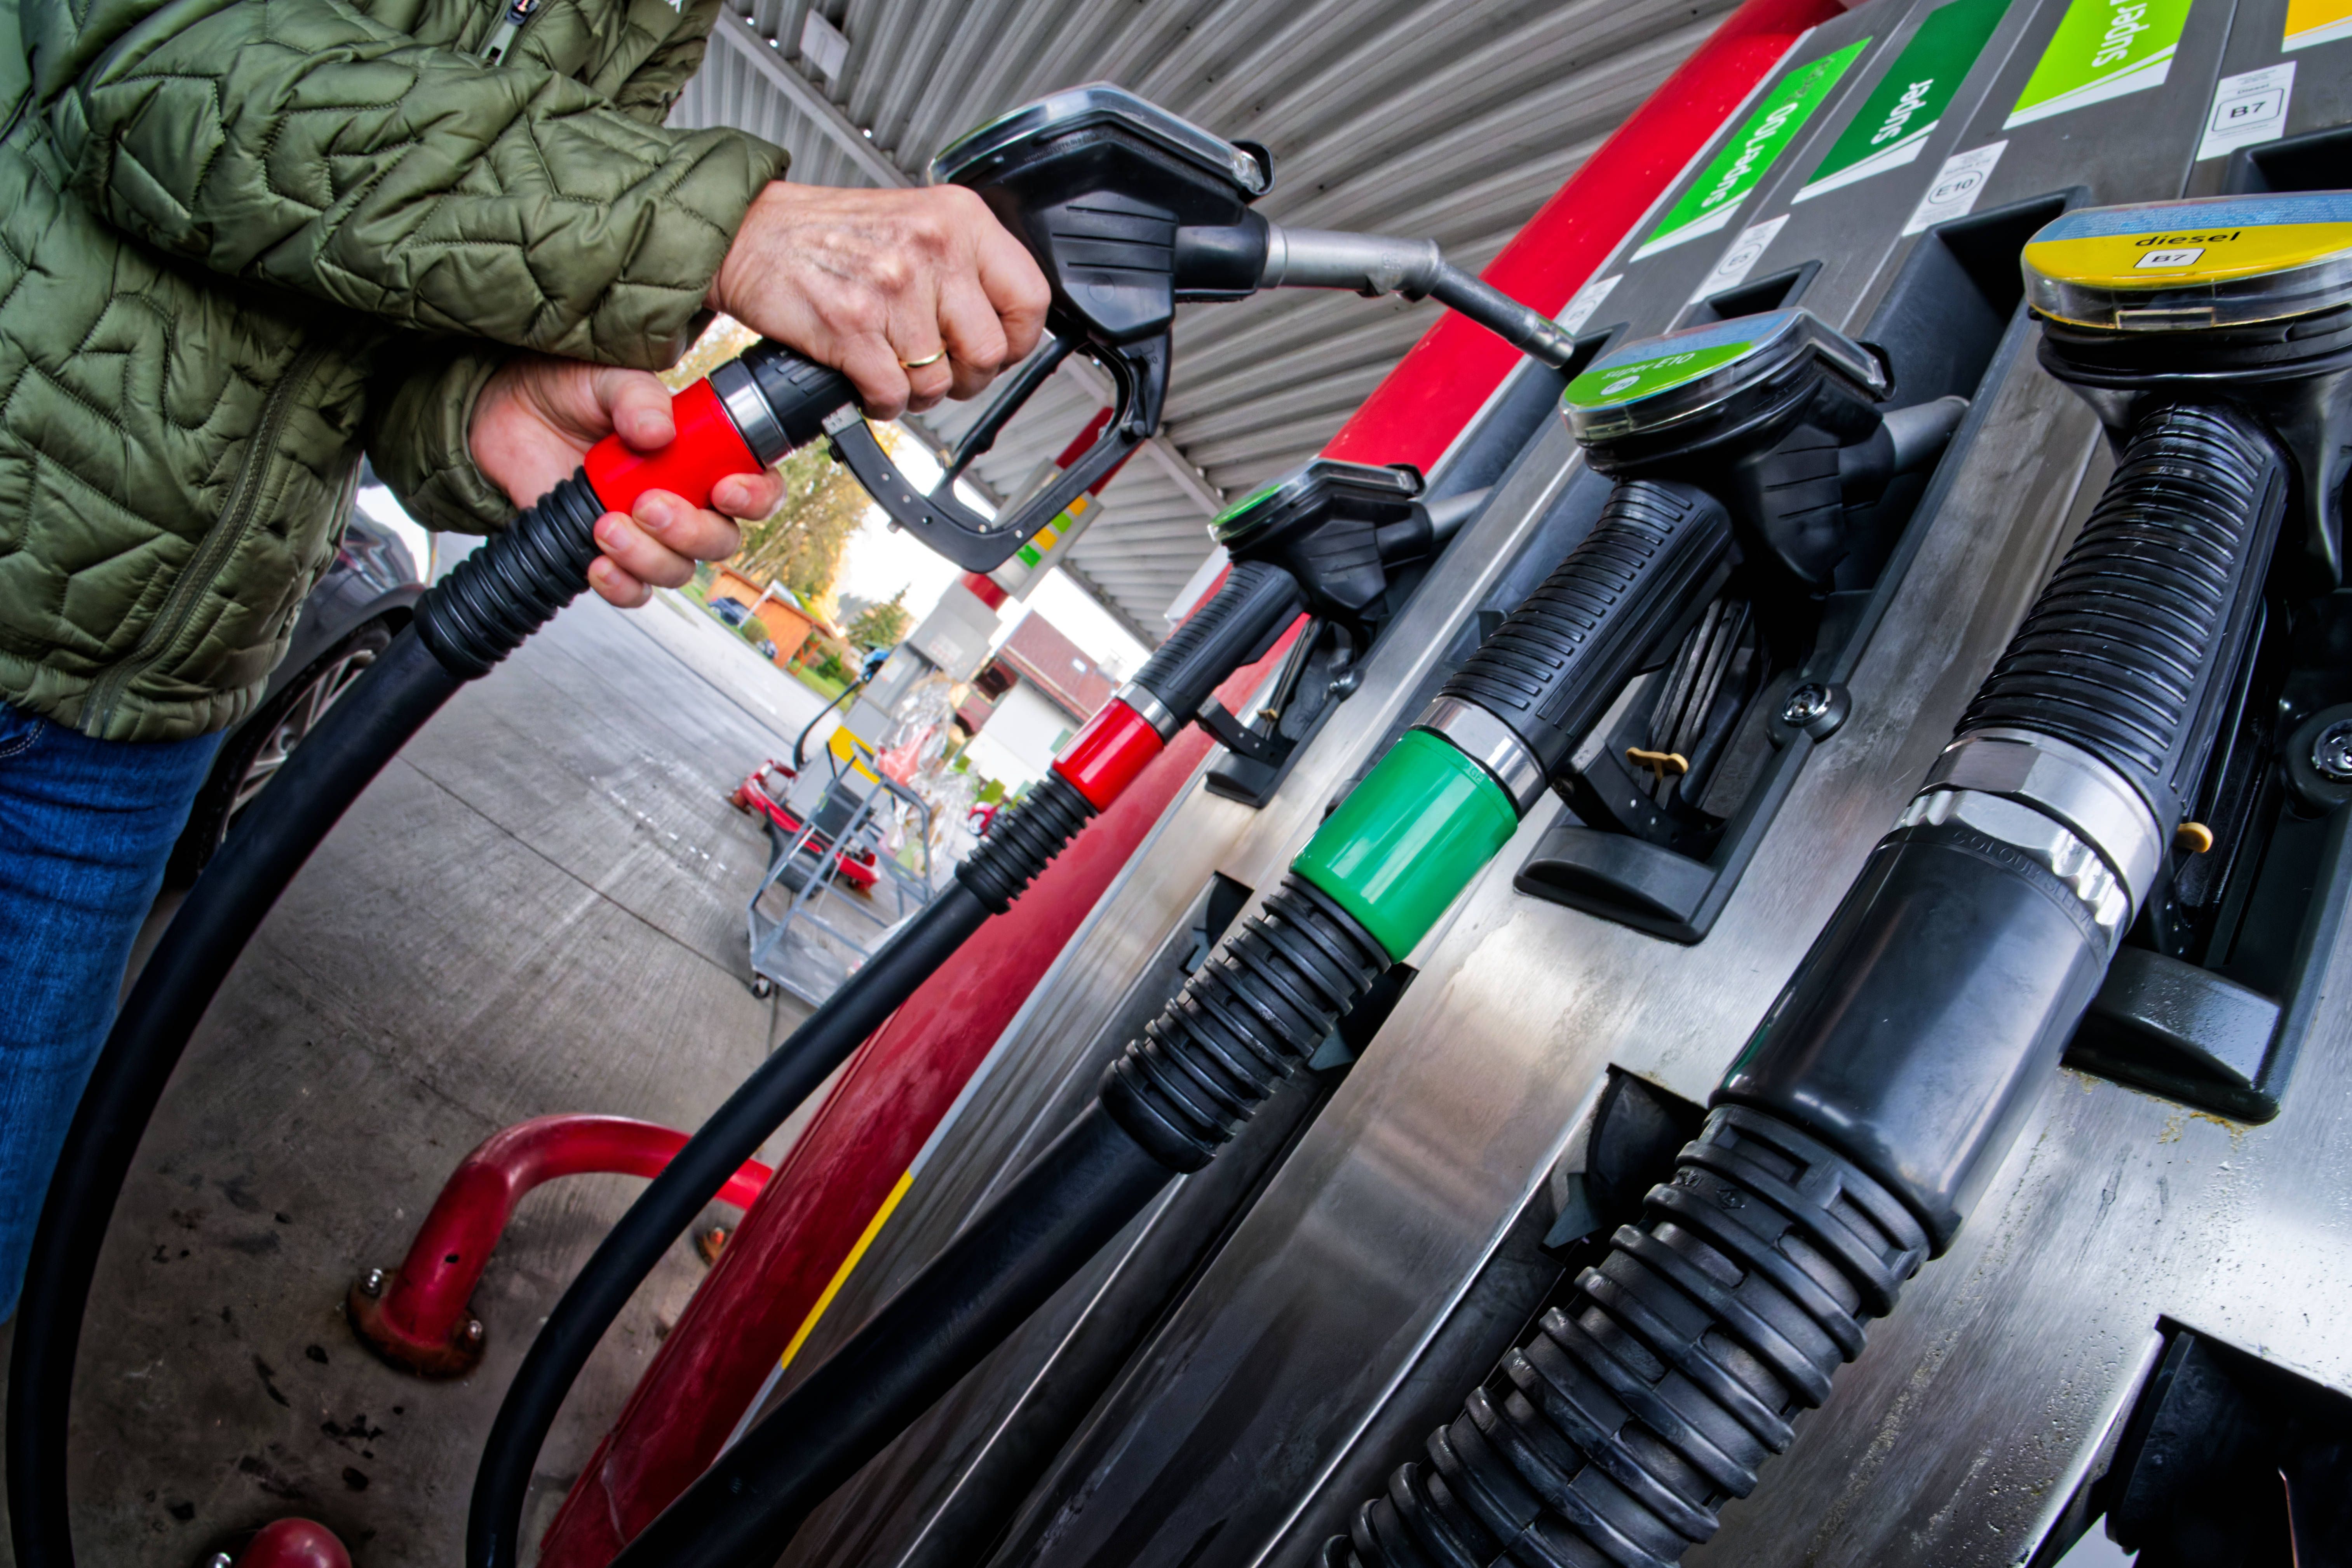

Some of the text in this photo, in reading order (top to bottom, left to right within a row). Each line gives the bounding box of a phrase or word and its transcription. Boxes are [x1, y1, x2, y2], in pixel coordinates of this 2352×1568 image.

[2091, 2, 2150, 68] super
[1870, 78, 1934, 145] super
[2230, 101, 2266, 118] B7
[1701, 145, 1765, 208] super
[1746, 102, 1799, 148] 100
[1936, 178, 1974, 197] E10
[2135, 231, 2241, 246] diesel
[2151, 254, 2188, 263] B7
[1601, 353, 1696, 380] super E10
